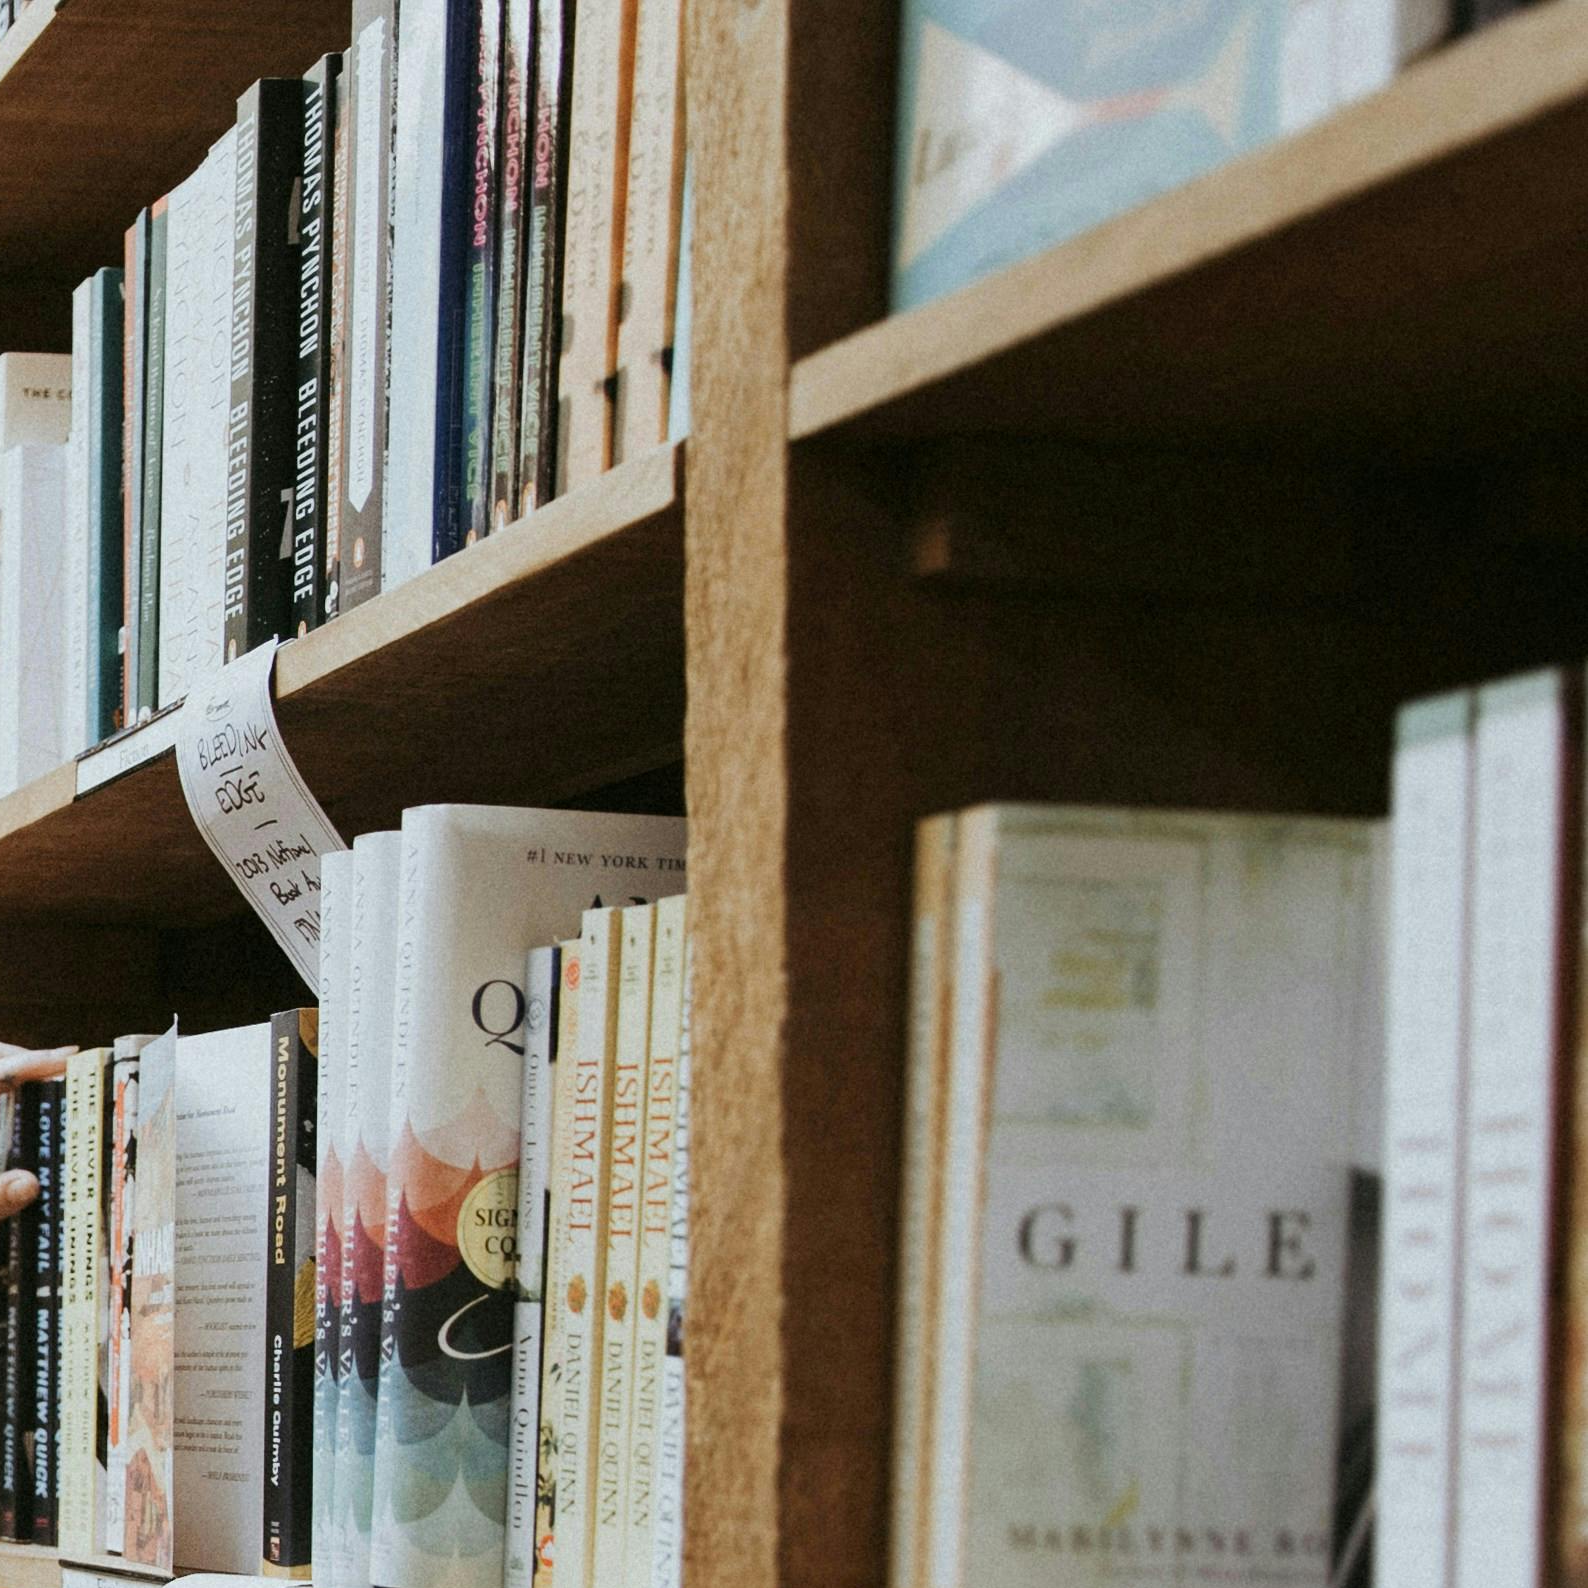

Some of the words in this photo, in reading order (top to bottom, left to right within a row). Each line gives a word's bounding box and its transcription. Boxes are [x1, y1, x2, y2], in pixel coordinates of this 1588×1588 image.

[234, 112, 255, 241] THOMAS
[301, 81, 323, 216] THOMAS
[230, 249, 253, 382] PYNCHON
[299, 218, 321, 358] PYNCHON
[24, 388, 49, 398] THE
[226, 400, 248, 541] BLEEDING
[295, 376, 318, 522] BLEEDING
[225, 547, 245, 622] EDGE
[293, 526, 314, 604] EDGE
[527, 848, 545, 863] #1
[553, 852, 593, 867] NEW
[601, 854, 649, 870] YORK
[39, 1101, 51, 1158] LOVE
[87, 1072, 96, 1107] THE
[276, 1036, 289, 1187] Monument
[38, 1166, 51, 1217] MAY
[70, 1131, 78, 1202] SILVER
[86, 1125, 95, 1198] SILVER
[568, 1060, 599, 1242] ISHMAEL
[610, 1063, 639, 1247] ISHMAEL
[644, 1057, 673, 1245] ISHMAEL
[37, 1222, 50, 1273] FAIL
[69, 1215, 77, 1305] LININGS
[84, 1211, 94, 1301] LININGS
[275, 1195, 286, 1264] Road
[340, 1202, 358, 1338] MILLER'S
[382, 1181, 401, 1324] MILLER'S
[1018, 1206, 1317, 1281] GILE
[37, 1308, 50, 1425] MATTHEW
[273, 1334, 282, 1404] Charlie
[518, 1335, 532, 1396] Anna
[565, 1334, 582, 1423] DANIEL
[605, 1342, 622, 1431] DANIEL
[639, 1341, 656, 1430] DANIEL
[3, 1424, 14, 1491] QUICK
[34, 1427, 49, 1499] QUICK
[513, 1407, 529, 1530] Quindlen
[561, 1431, 578, 1514] QUINN
[601, 1441, 619, 1526] QUINN
[634, 1441, 653, 1527] QUINN
